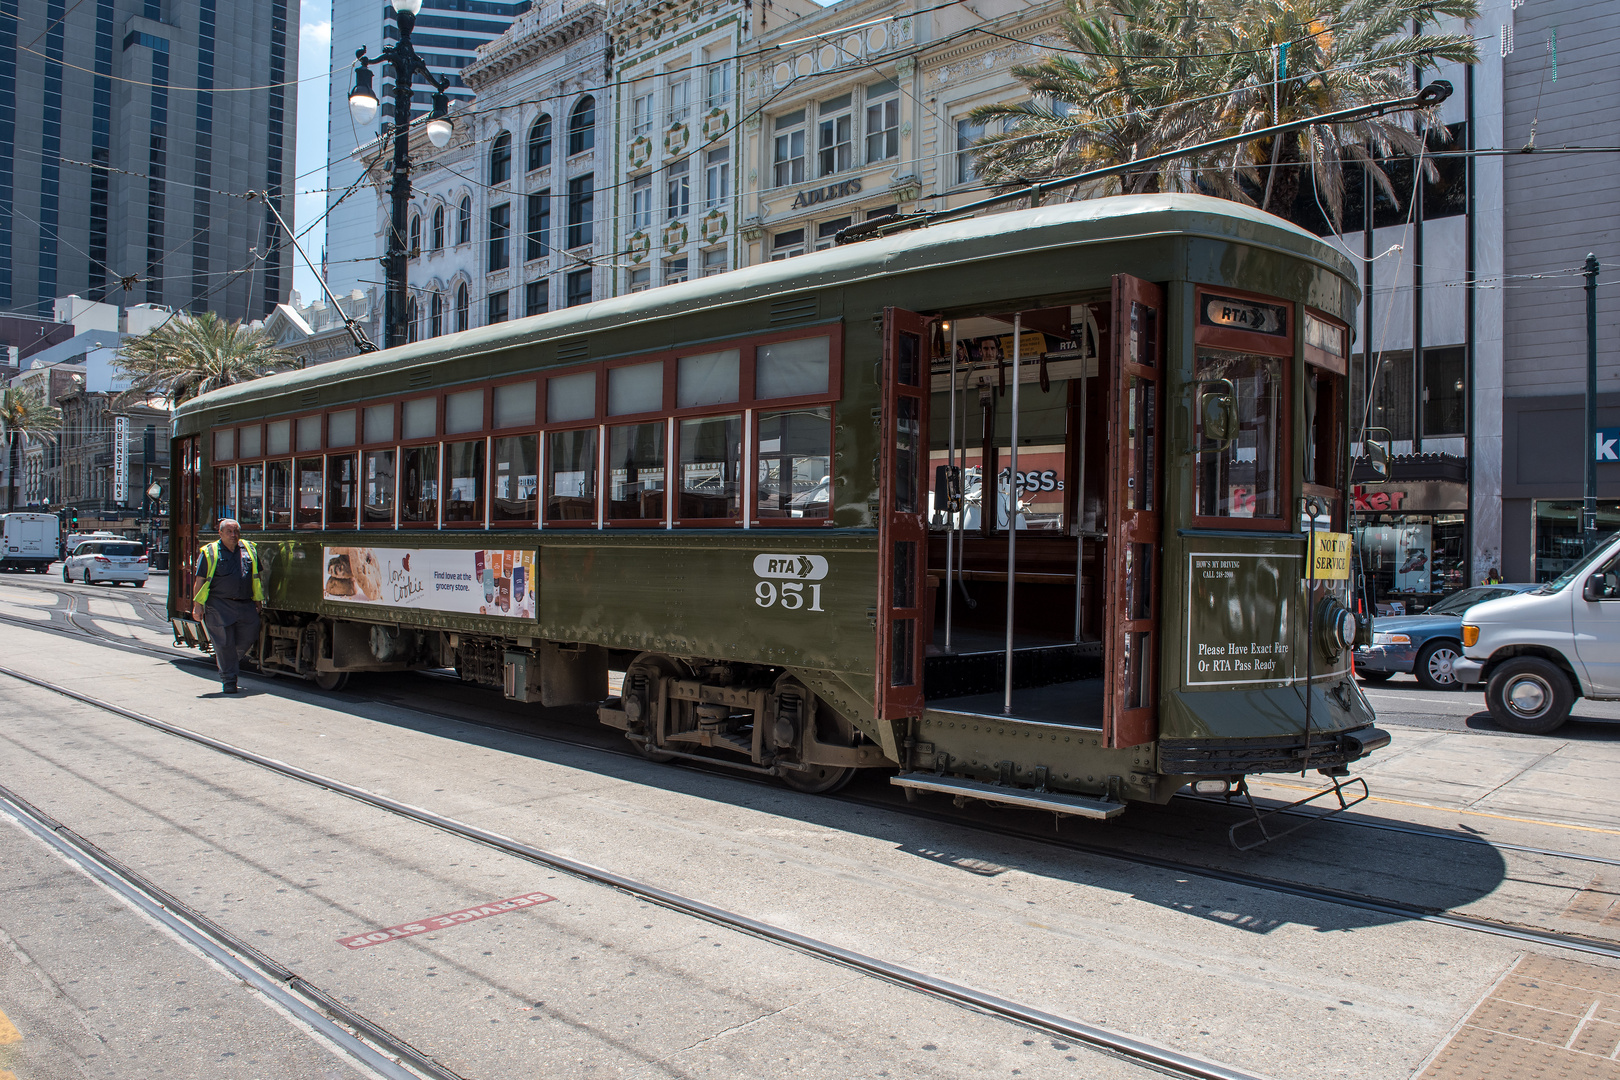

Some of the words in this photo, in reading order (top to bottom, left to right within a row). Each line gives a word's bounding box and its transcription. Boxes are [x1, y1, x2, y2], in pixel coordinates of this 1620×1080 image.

[791, 178, 862, 210] ADLER'S
[1221, 306, 1248, 323] RTA
[1060, 340, 1077, 351] RTA
[1596, 432, 1620, 460] k
[1350, 485, 1405, 510] ker
[1320, 539, 1337, 552] NOT
[1339, 540, 1346, 552] IN
[767, 559, 795, 573] RTA
[1211, 560, 1220, 569] MY
[1220, 560, 1240, 569] DRIVING
[1315, 557, 1345, 570] SERVICE
[434, 571, 445, 580] Find
[445, 571, 457, 581] love
[457, 572, 463, 581] at
[463, 572, 472, 582] the
[1202, 570, 1215, 579] CALL
[436, 583, 455, 593] grocery
[455, 583, 470, 592] store.
[755, 581, 825, 612] 951
[1198, 643, 1226, 656] Please
[1228, 642, 1248, 655] Have
[1250, 642, 1272, 655] Exact
[1274, 641, 1289, 654] Fare
[1198, 659, 1210, 673] Or
[1212, 659, 1231, 672] RTA
[1234, 658, 1252, 672] Pass
[1254, 658, 1276, 673] Ready
[431, 893, 549, 926] SERVICE
[348, 923, 427, 947] STOP
